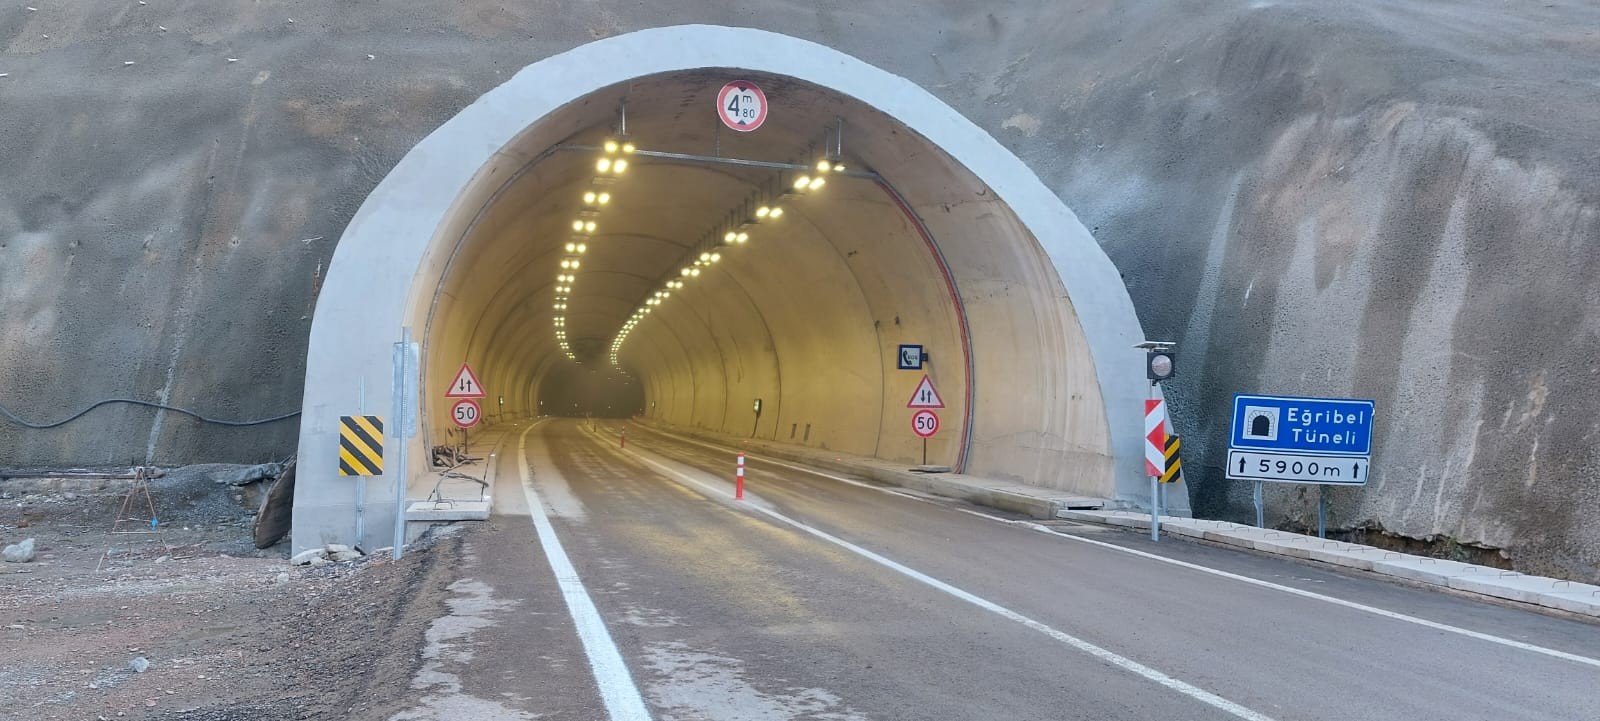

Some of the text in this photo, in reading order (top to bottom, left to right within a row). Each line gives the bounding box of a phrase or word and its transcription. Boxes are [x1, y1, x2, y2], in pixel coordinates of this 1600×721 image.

[727, 94, 753, 117] 4 m
[742, 108, 755, 119] 80
[456, 406, 475, 420] 50
[1287, 407, 1364, 426] Eğribel
[917, 416, 935, 430] 50
[1291, 428, 1356, 445] Tüneli
[1258, 459, 1340, 477] 5900m
